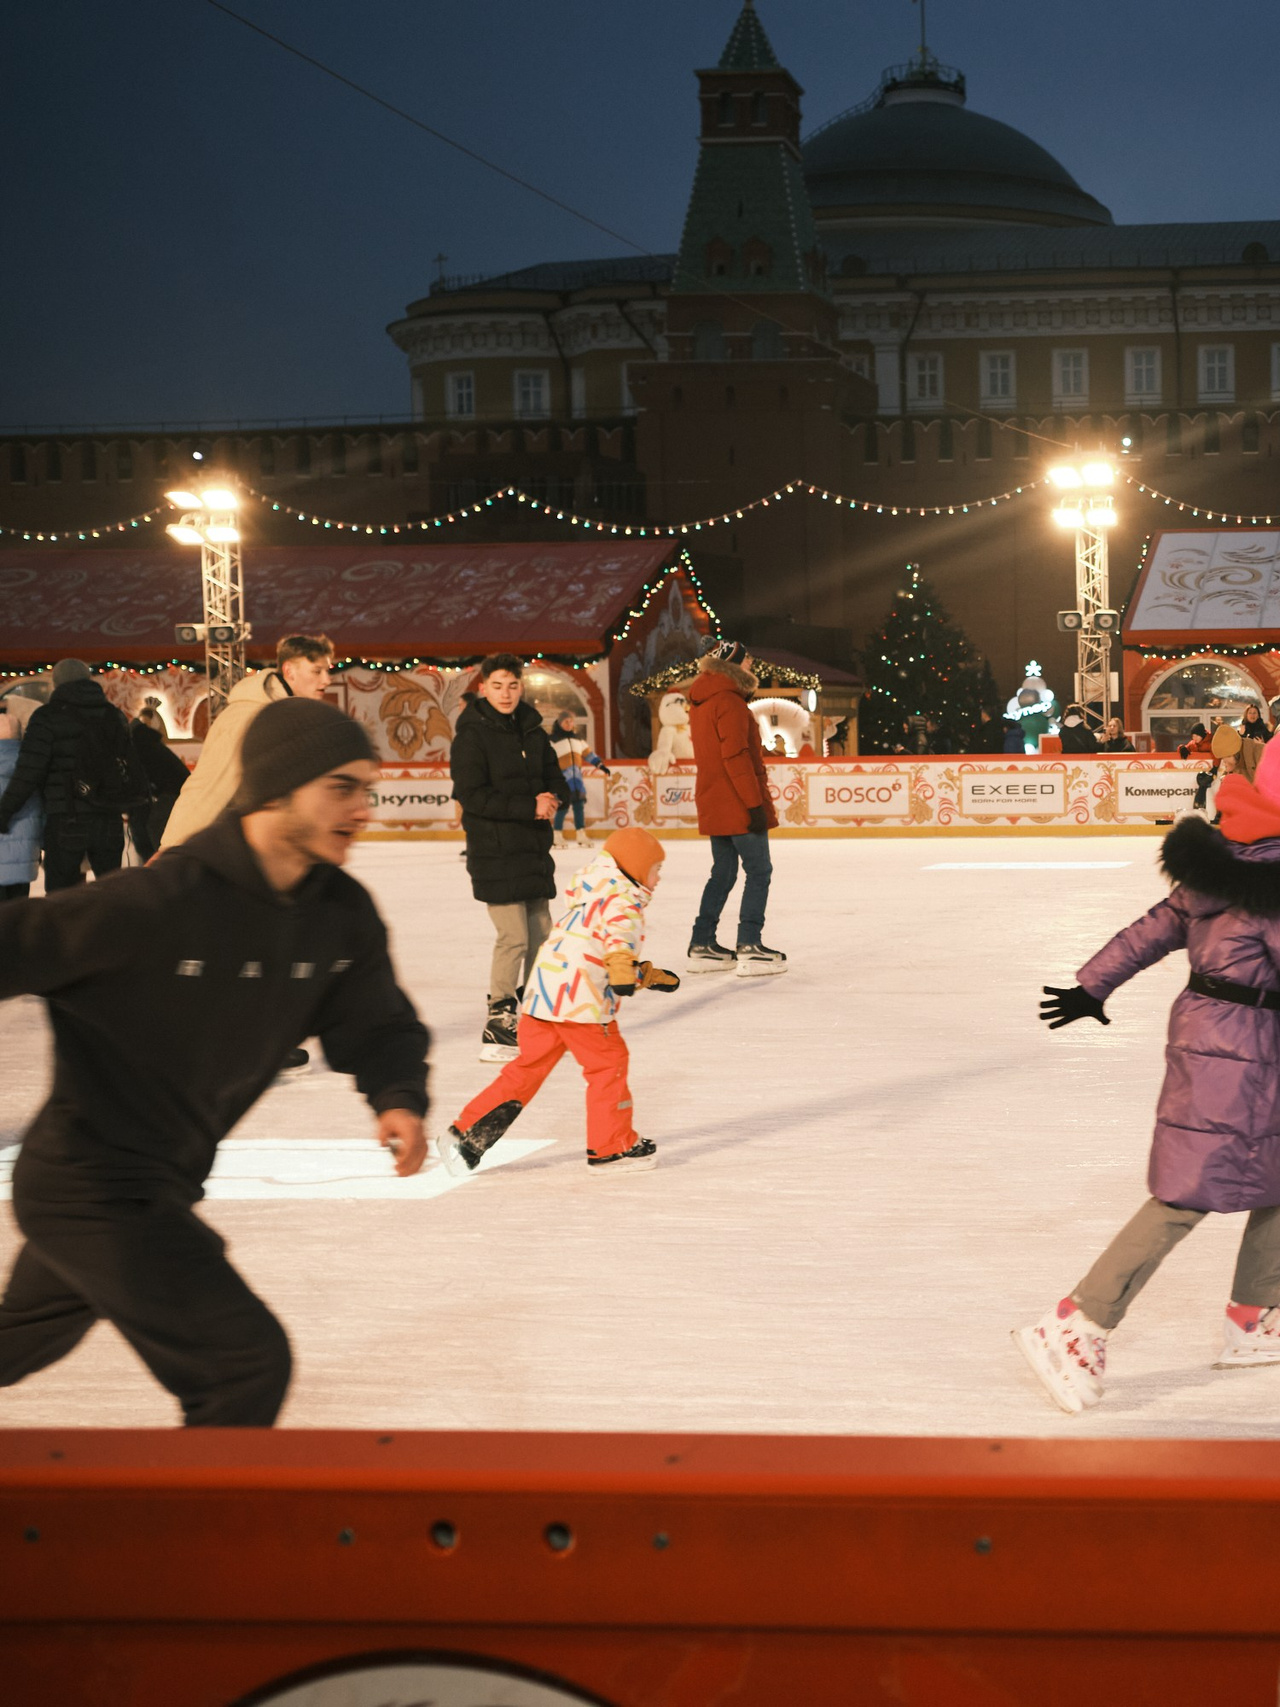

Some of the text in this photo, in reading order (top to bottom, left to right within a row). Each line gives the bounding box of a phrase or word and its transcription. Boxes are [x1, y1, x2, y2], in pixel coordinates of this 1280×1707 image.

[825, 787, 892, 804] BOSCO
[971, 784, 1055, 796] EXEED
[1125, 786, 1198, 798] Коммерсан
[381, 794, 449, 806] купер
